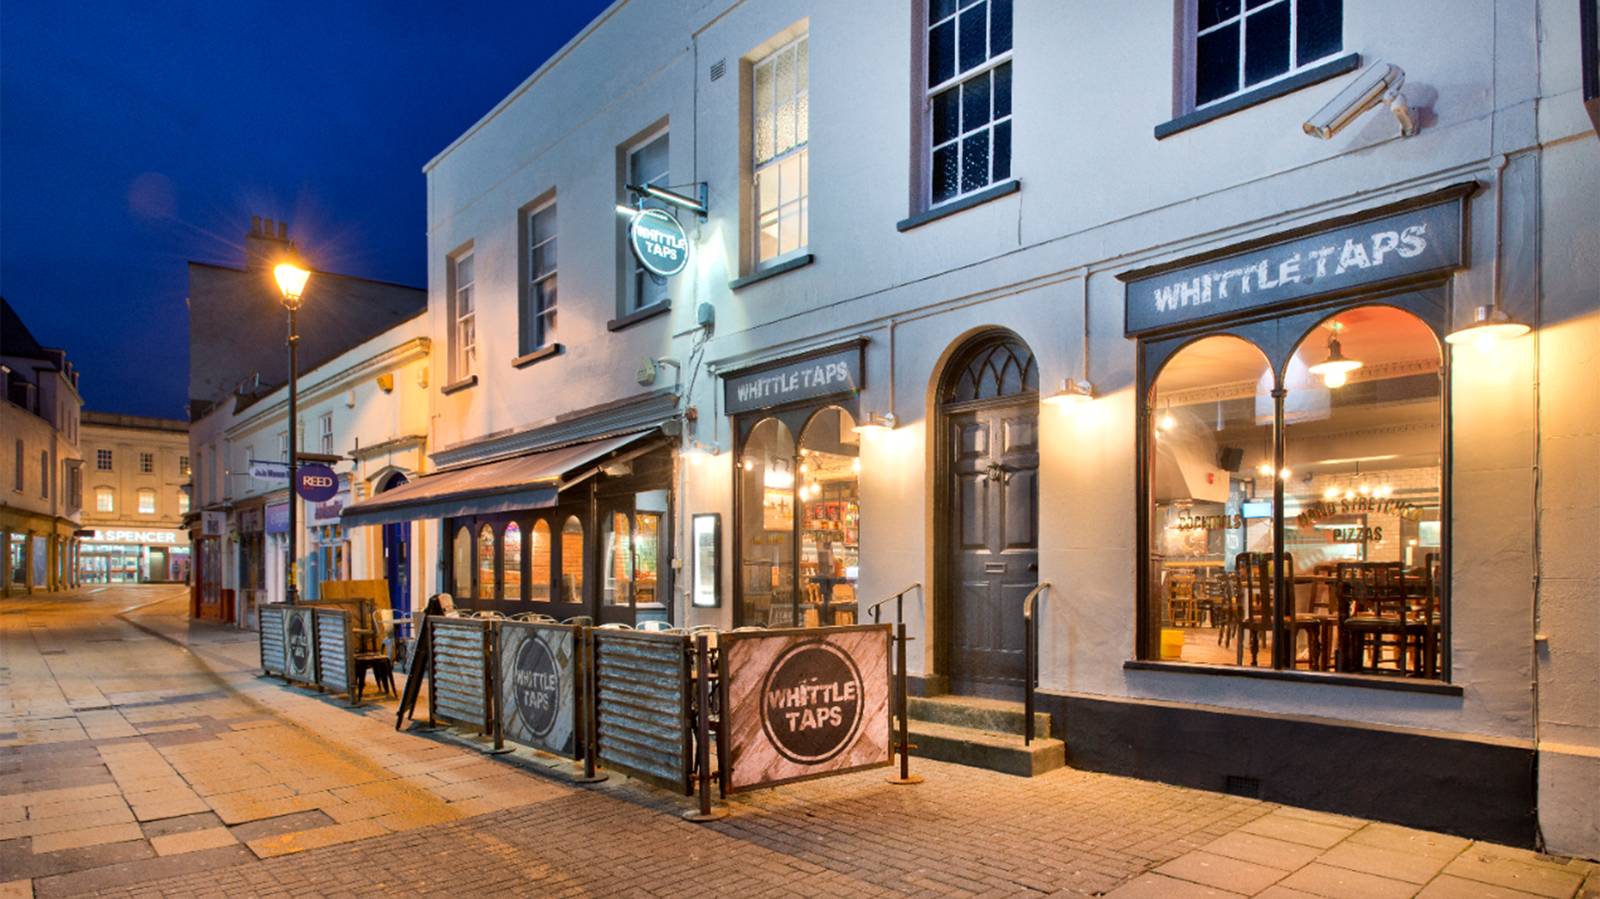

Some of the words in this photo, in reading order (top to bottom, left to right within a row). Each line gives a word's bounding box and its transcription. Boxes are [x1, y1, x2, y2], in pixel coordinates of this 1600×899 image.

[637, 225, 687, 250] WHITTLE
[645, 240, 677, 260] TAPS
[1154, 256, 1300, 313] WHITTLE
[1308, 223, 1427, 277] TAPS
[736, 370, 799, 402] WHITTLE
[802, 360, 848, 388] TAPS
[303, 475, 333, 488] REED
[106, 530, 176, 543] SPENCER
[1333, 526, 1383, 543] PIZZAS
[516, 669, 556, 691] WHITTLE
[523, 688, 550, 710] TAPS
[768, 680, 857, 710] WHITTLE
[786, 705, 842, 732] TAPS
